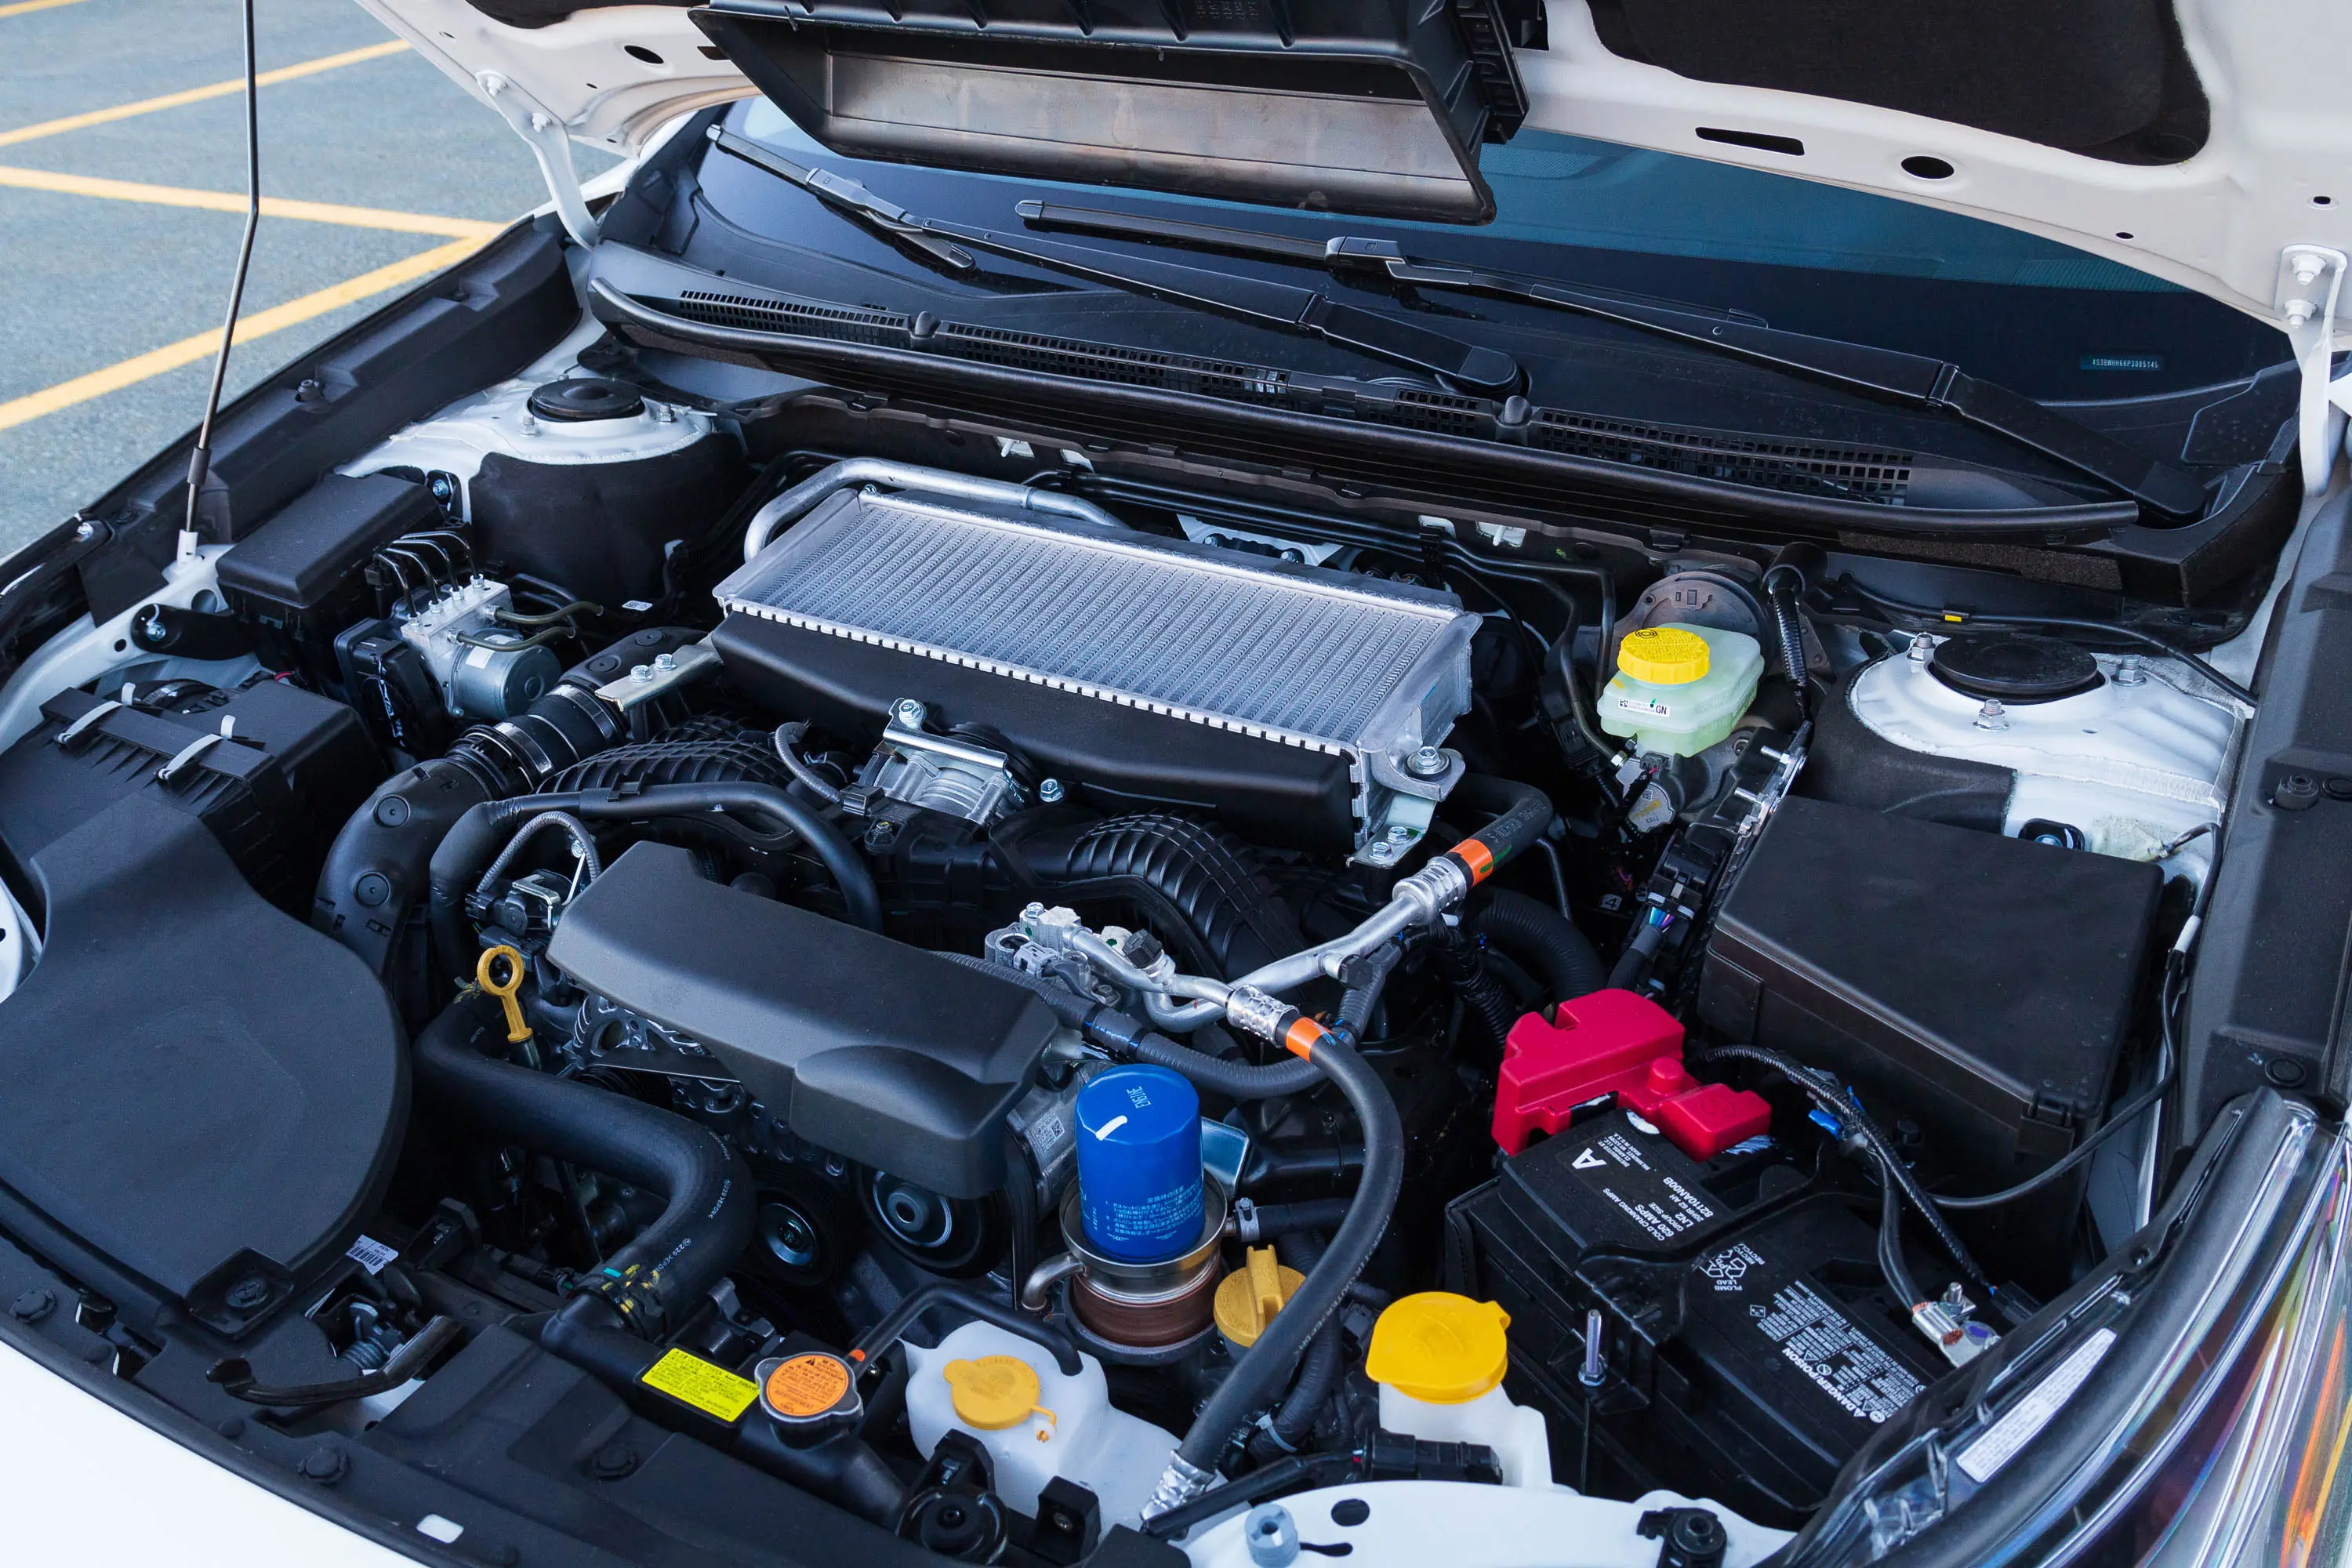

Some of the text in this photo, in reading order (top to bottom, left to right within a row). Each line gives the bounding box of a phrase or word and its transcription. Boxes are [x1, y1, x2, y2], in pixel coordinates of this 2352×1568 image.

[1655, 705, 1668, 716] GN
[1571, 1147, 1607, 1170] A
[1661, 1176, 1715, 1217] 82110AN00B
[1602, 1187, 1665, 1240] COLD CRANKING AMPS
[1634, 1203, 1675, 1236] 620 AMPS
[1647, 1202, 1684, 1231] GROUP SIZE
[1674, 1212, 1694, 1227] LN2
[1782, 1347, 1856, 1414] DANGER/POISON
